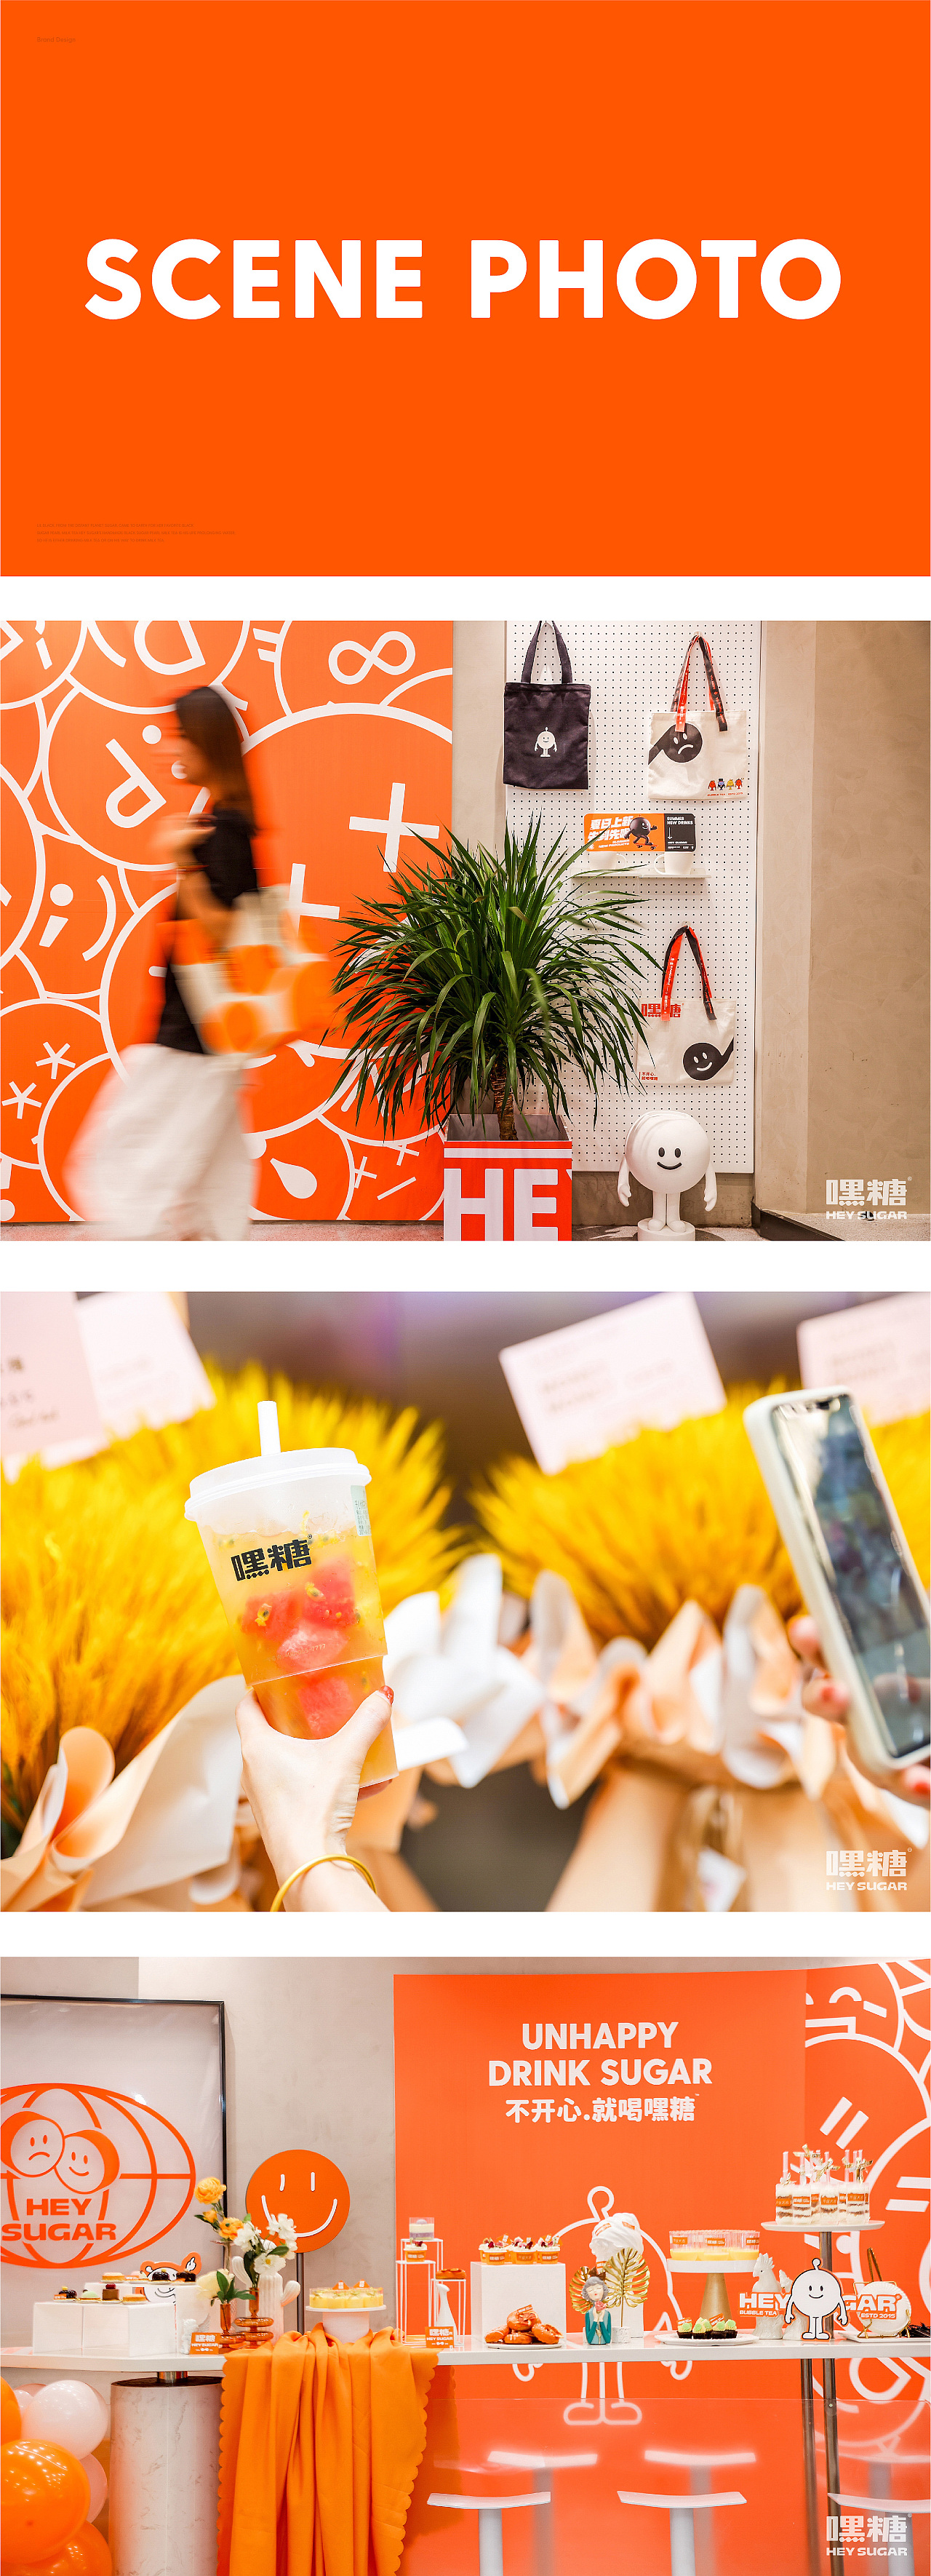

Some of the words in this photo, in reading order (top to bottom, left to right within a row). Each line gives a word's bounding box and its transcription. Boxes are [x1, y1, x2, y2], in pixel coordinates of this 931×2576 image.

[590, 815, 634, 830] 夏日上新
[231, 1539, 312, 1581] 嘿糖
[522, 2022, 679, 2050] UNHAPPY
[489, 2060, 591, 2086] DRINK
[601, 2058, 713, 2086] SUGAR
[27, 2198, 92, 2216] HEY
[2, 2223, 116, 2241] SUGAR
